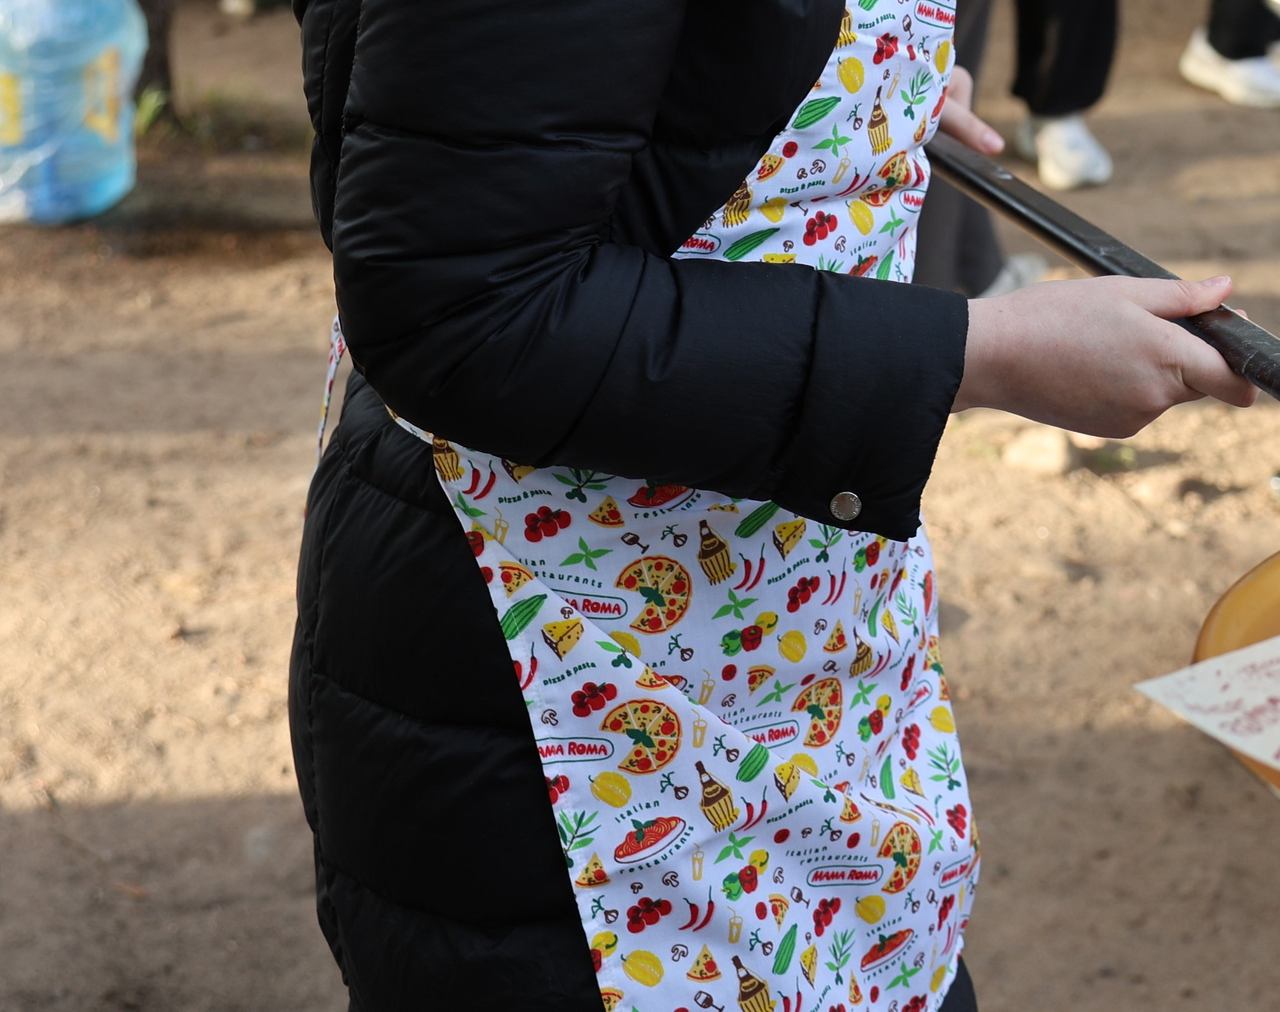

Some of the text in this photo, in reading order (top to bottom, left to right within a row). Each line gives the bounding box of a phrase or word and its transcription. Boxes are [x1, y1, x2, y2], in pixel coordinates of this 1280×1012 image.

[917, 2, 956, 25] MAMA ROMA
[582, 599, 622, 616] ROMA
[573, 662, 597, 674] pasta
[768, 726, 796, 743] ROMA
[567, 741, 608, 756] ROMA
[619, 825, 695, 875] restaurants
[799, 854, 868, 866] restaurants
[811, 868, 879, 883] MAMA ROMA
